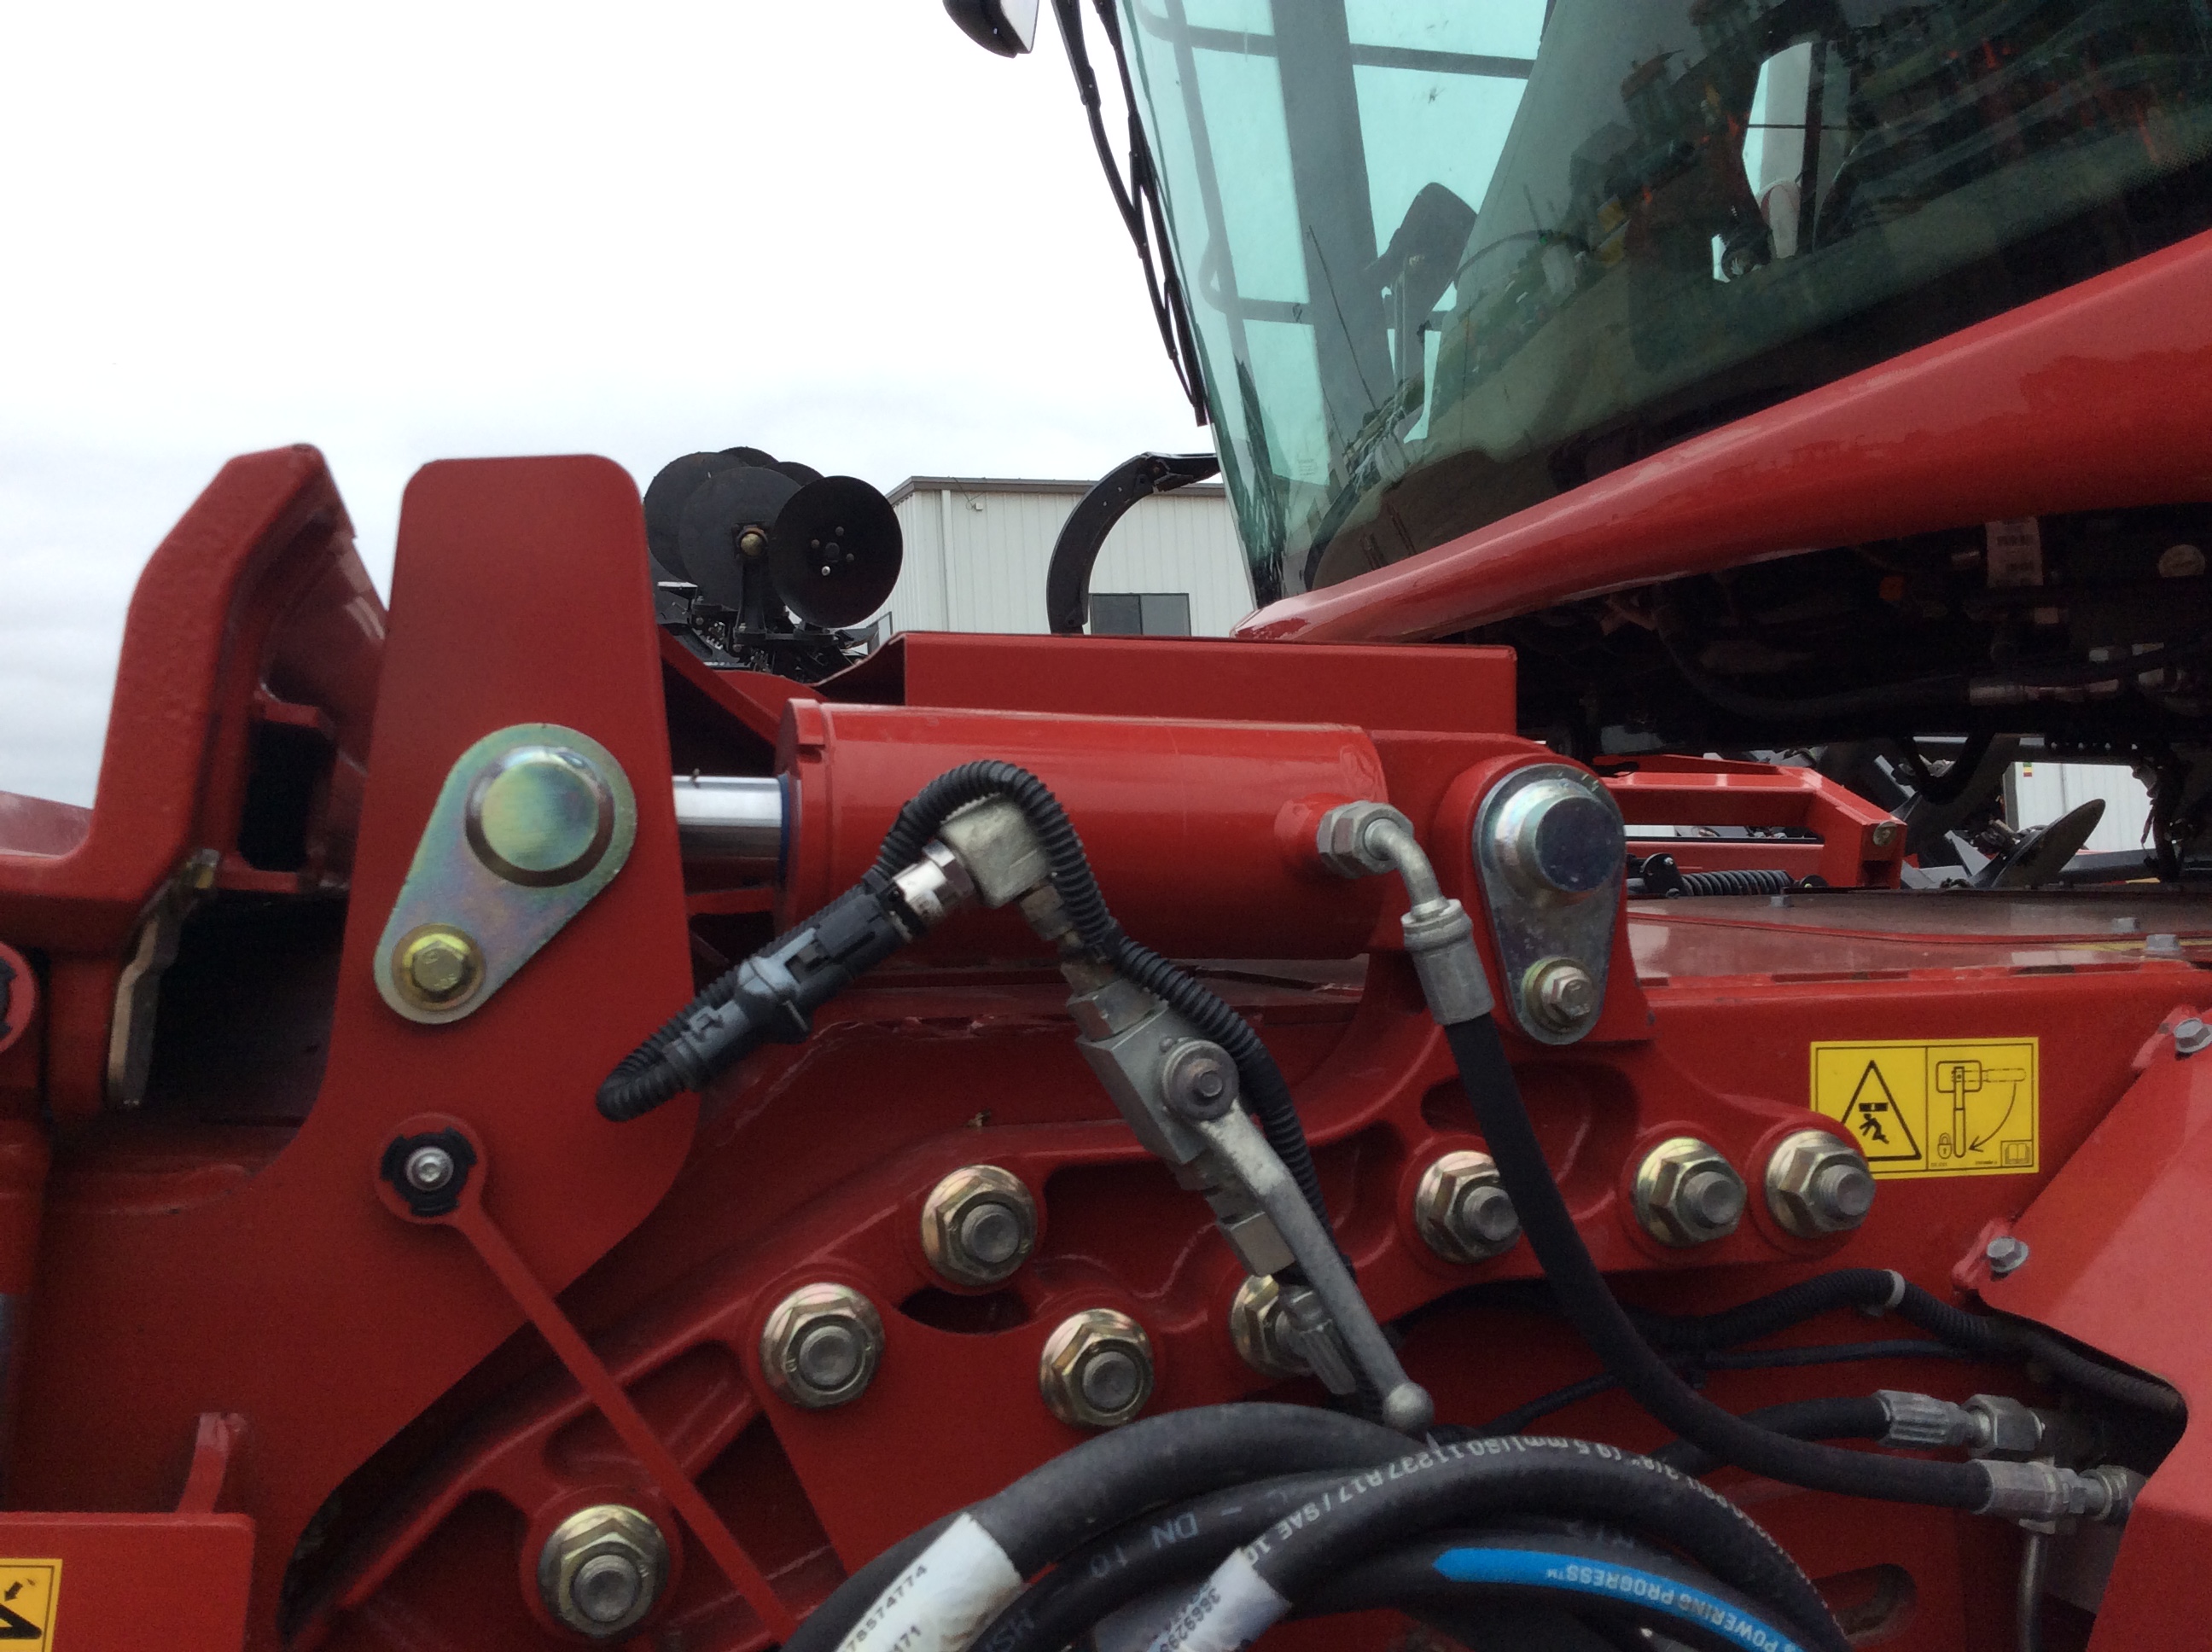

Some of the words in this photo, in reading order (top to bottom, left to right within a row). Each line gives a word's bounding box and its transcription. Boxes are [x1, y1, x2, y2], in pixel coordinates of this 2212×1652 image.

[1339, 1469, 1384, 1503] R17
[1151, 1512, 1199, 1550] DN
[1275, 1502, 1321, 1540] SAE
[1679, 1592, 1779, 1652] POWERING
